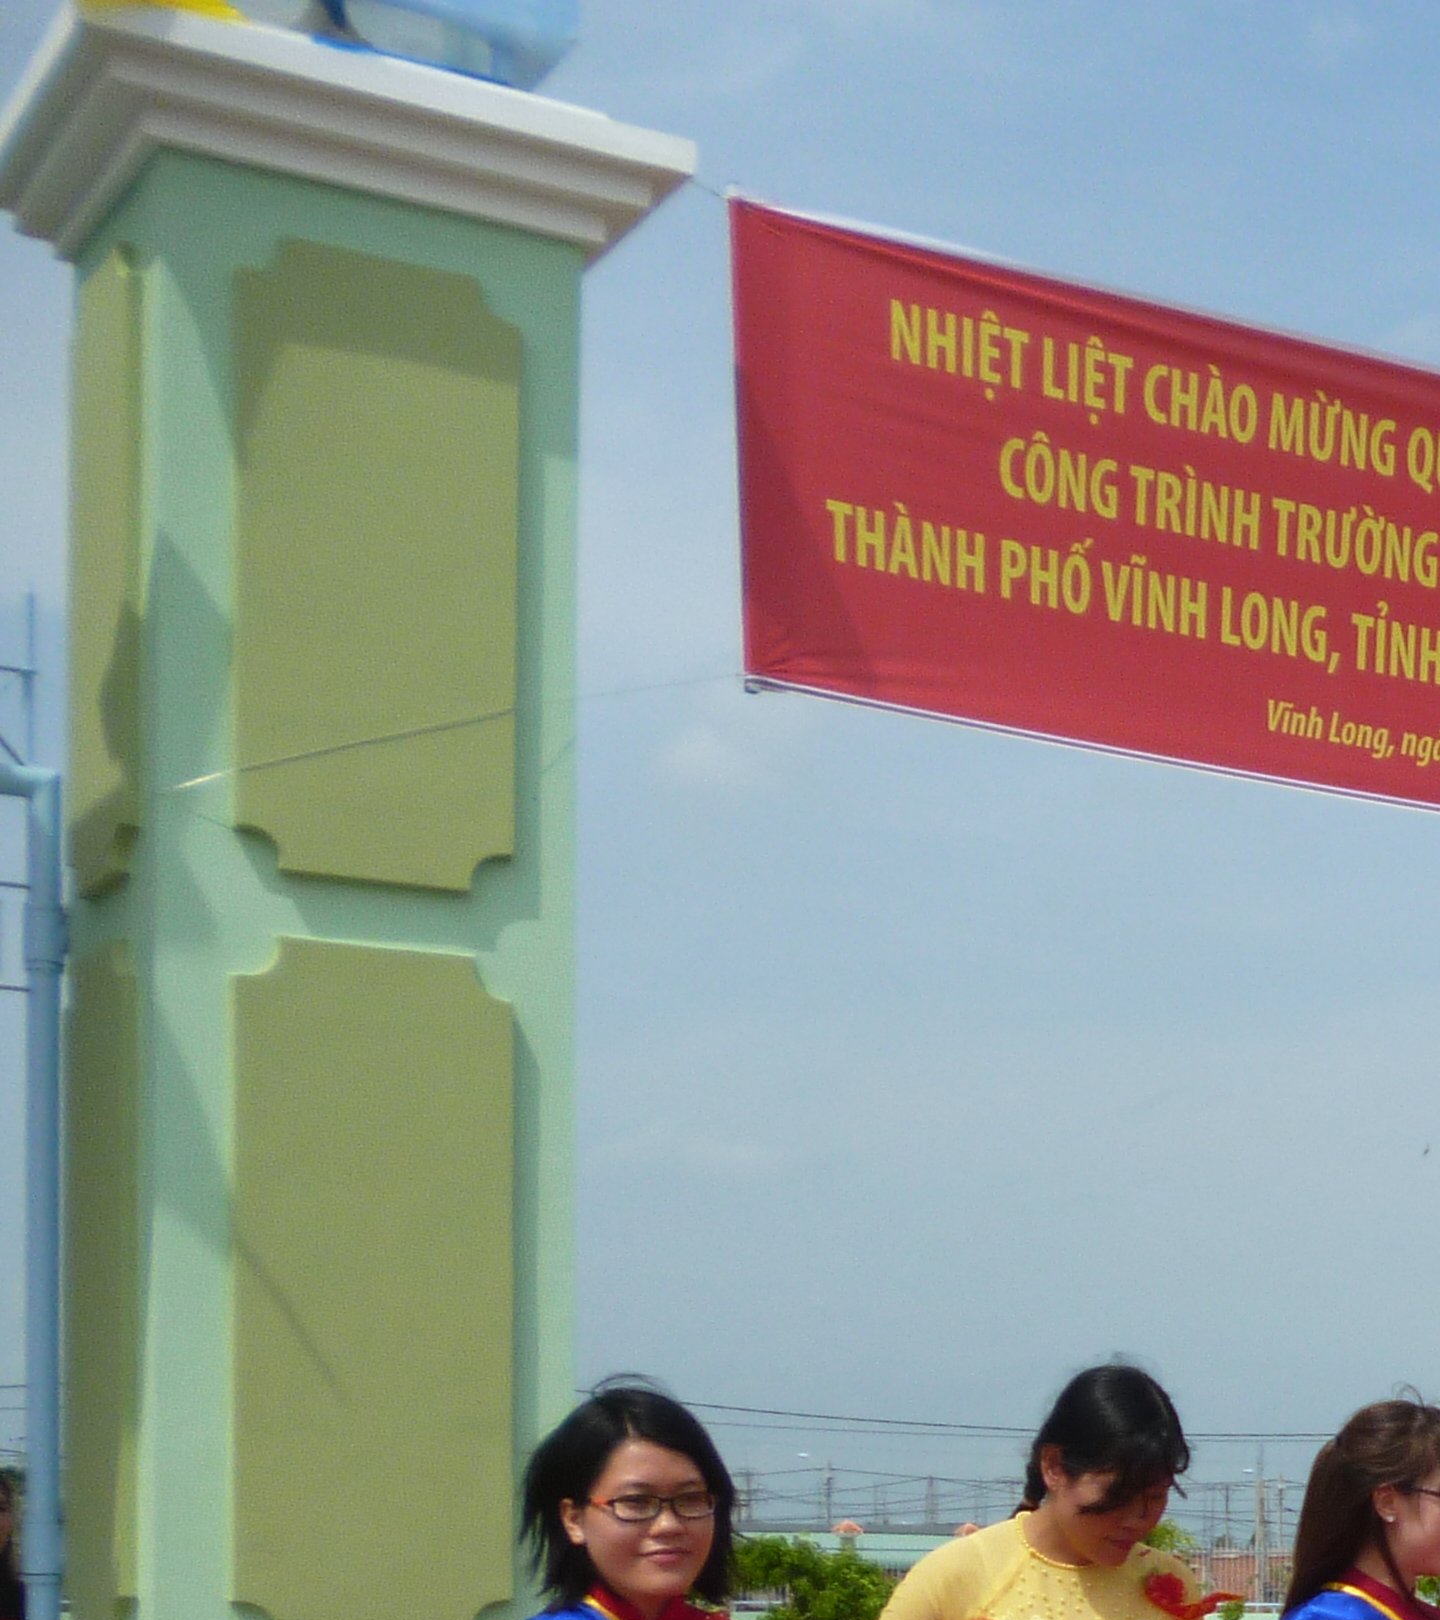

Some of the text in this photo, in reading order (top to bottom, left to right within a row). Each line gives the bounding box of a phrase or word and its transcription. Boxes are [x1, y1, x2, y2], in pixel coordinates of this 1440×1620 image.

[890, 298, 1030, 401] NHIỆT
[1042, 335, 1134, 425] LIỆT
[1143, 364, 1258, 444] CHÀO
[1268, 391, 1396, 477] MỪNG
[825, 498, 986, 594] THÀNH
[1000, 537, 1094, 615] PHỐ
[1101, 554, 1208, 640] VĨNH
[1220, 586, 1341, 674] LONG,
[999, 430, 1119, 520] CÔNG
[1129, 464, 1261, 551] TRÌNH
[1272, 497, 1439, 589] TRƯỜNG
[1267, 699, 1324, 740] Vĩnh
[1328, 713, 1395, 760] Long,
